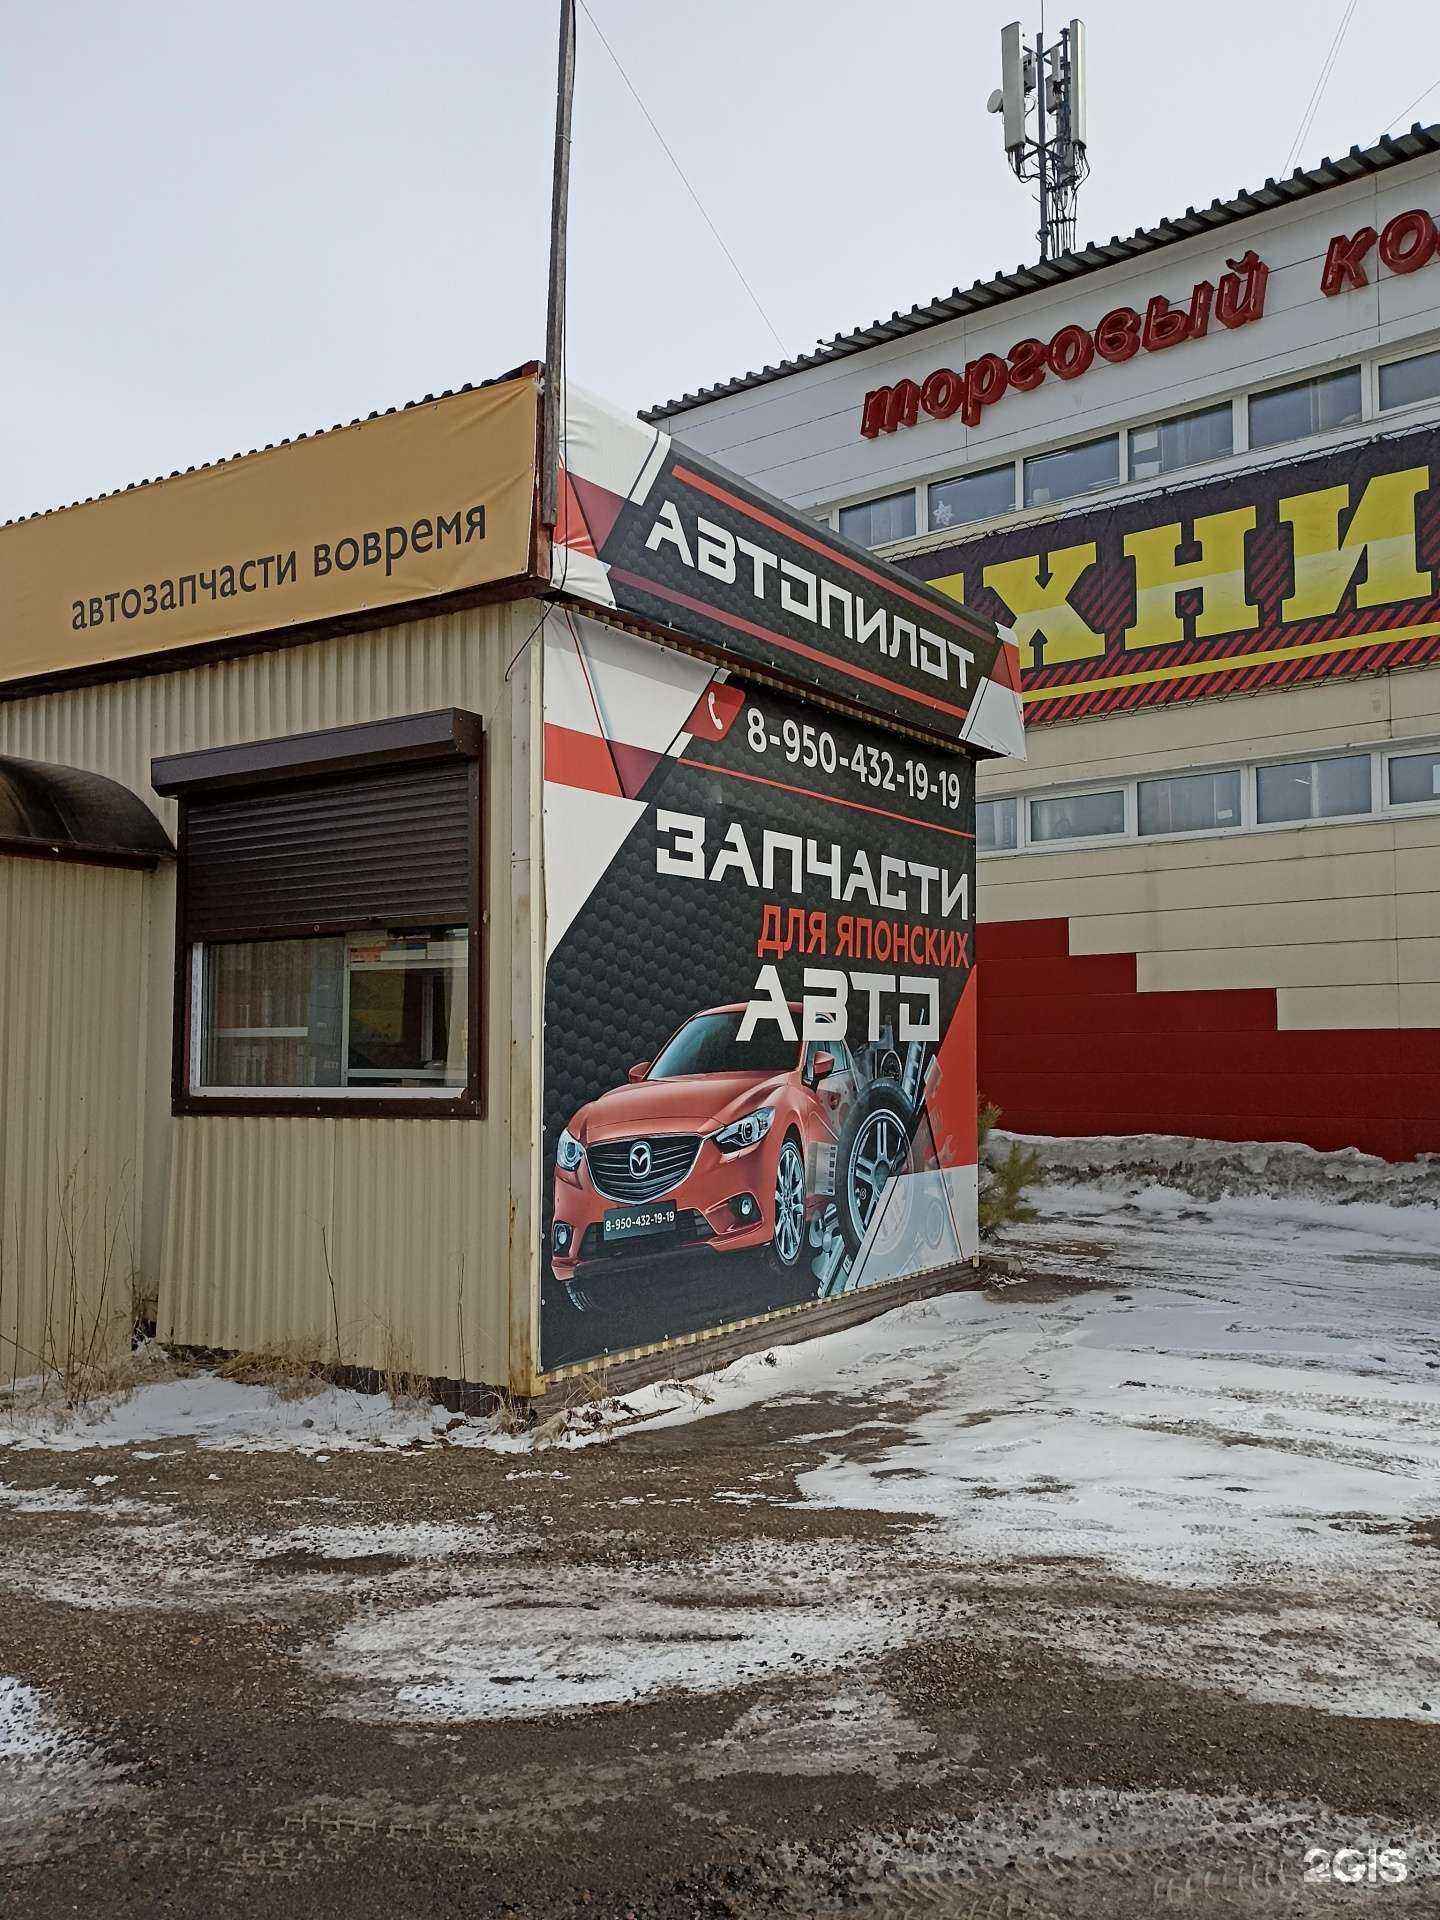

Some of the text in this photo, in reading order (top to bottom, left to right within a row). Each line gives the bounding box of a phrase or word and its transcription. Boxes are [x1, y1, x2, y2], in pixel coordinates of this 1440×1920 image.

[860, 208, 1440, 439] торговый ко
[72, 504, 486, 630] автозапчасти вовремя
[645, 500, 975, 689] АВТОПИЛОТ
[747, 707, 961, 810] 8-950-432-19-19
[656, 808, 969, 921] ЗАПЧАСТИ
[757, 904, 970, 969] ДЛЯ ЯПОНСКИХ
[735, 964, 940, 1042] АВТО
[605, 1210, 675, 1231] 8-950-432-19-19
